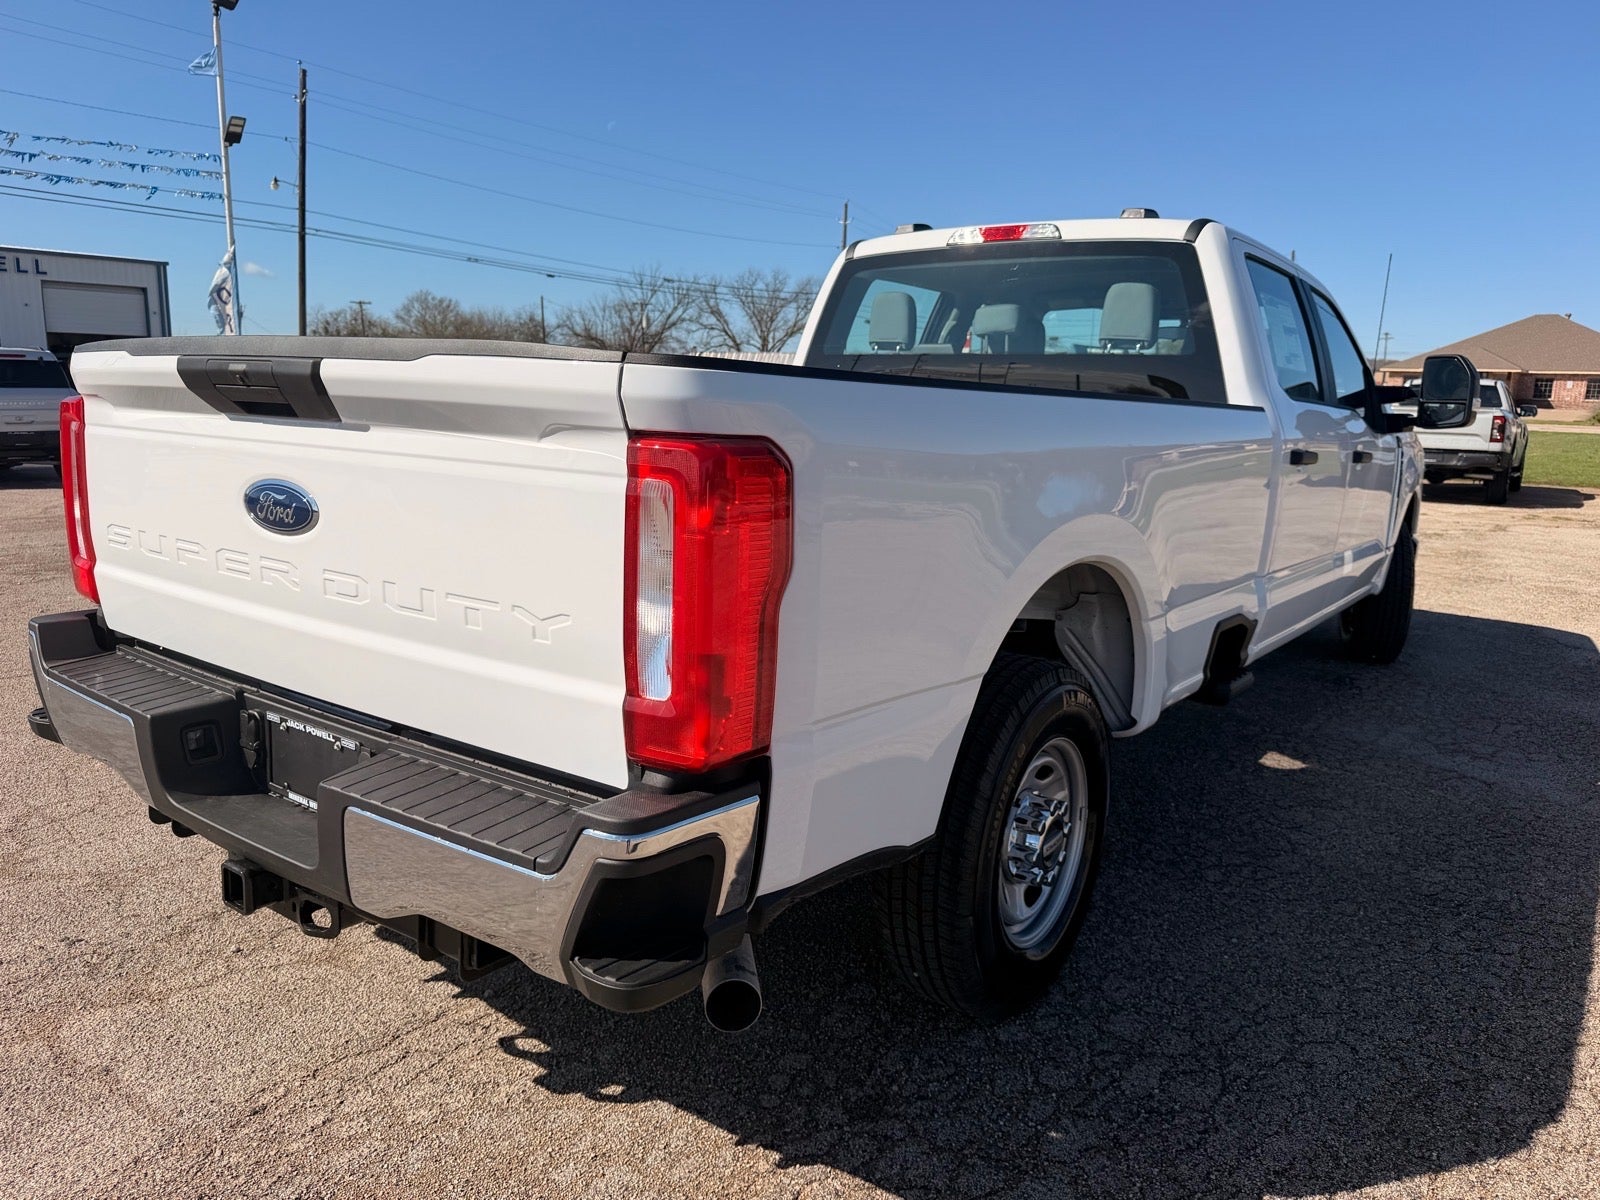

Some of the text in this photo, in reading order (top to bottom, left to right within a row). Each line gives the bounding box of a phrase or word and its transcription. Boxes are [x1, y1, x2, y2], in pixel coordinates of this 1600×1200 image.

[256, 490, 296, 524] Ford
[106, 523, 572, 644] SUPER DUTY
[286, 719, 336, 743] JACK POWELL
